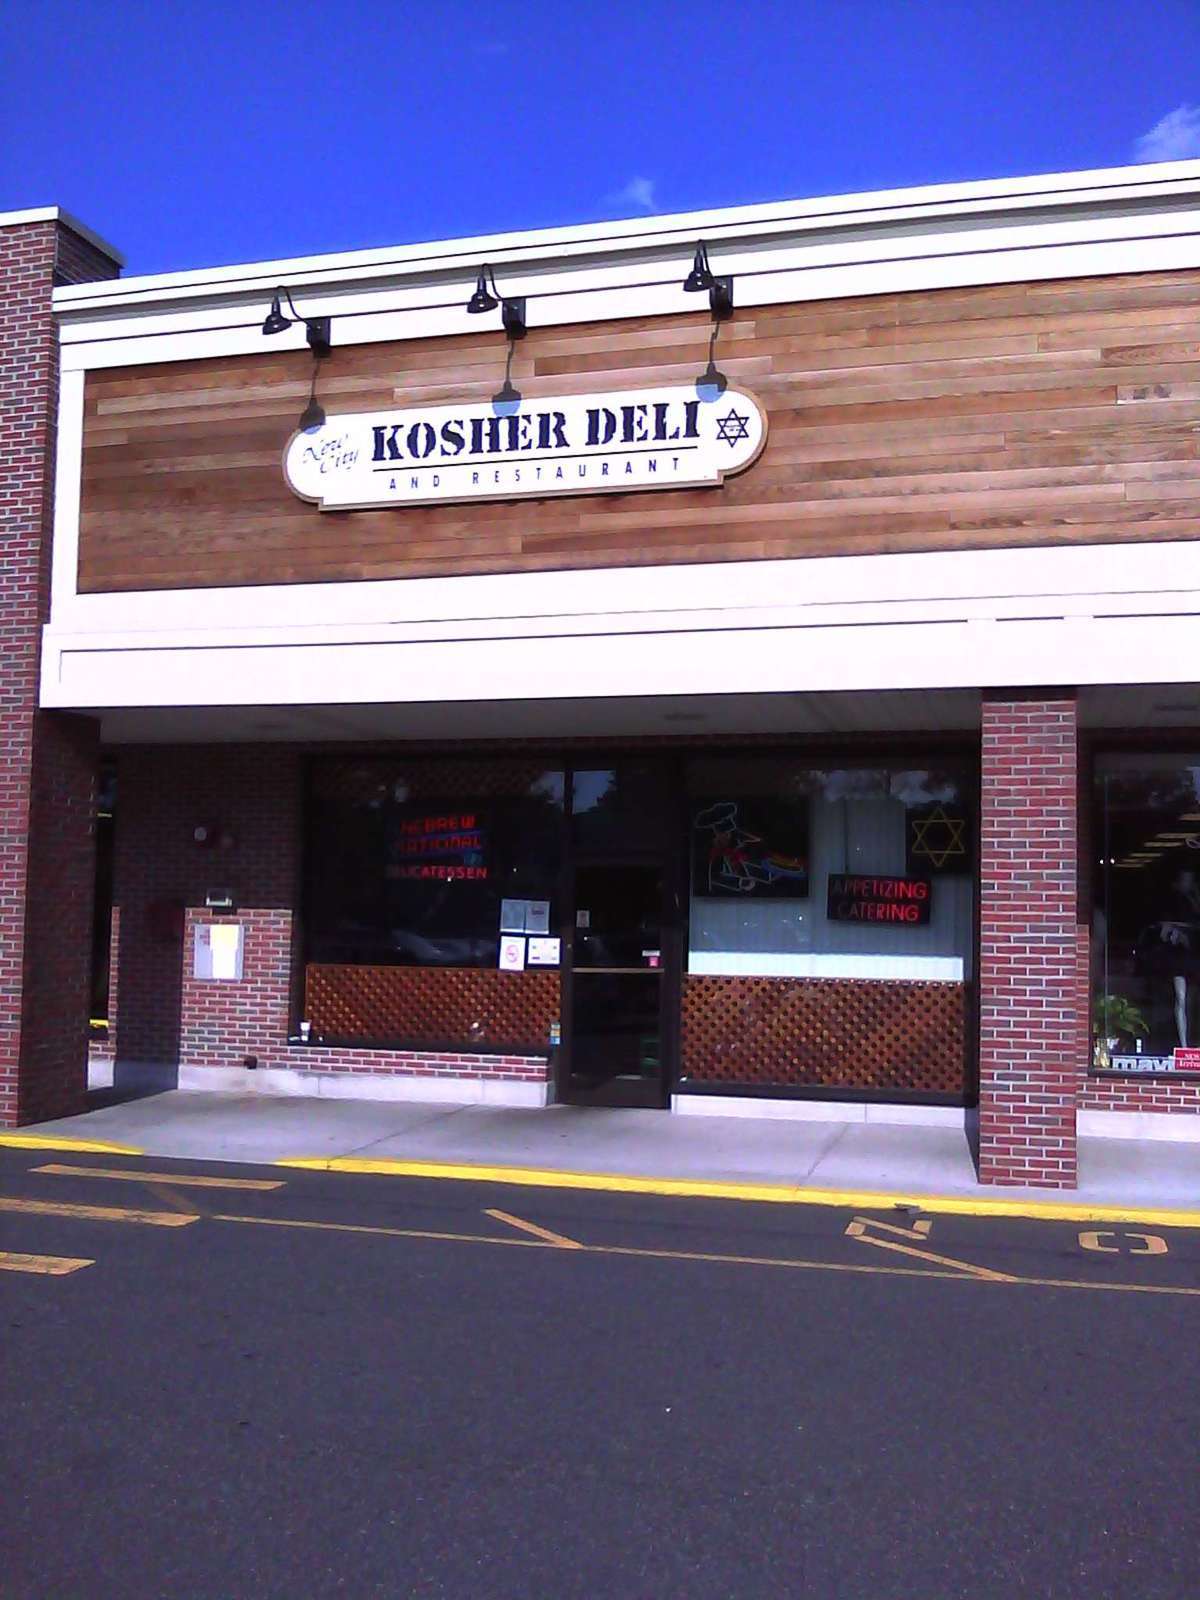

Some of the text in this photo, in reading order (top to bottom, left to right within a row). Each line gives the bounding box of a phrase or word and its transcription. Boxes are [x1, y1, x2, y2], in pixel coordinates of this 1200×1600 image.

[371, 400, 700, 461] KOSHER DELI
[389, 458, 679, 489] AND RESTAURANT
[393, 834, 482, 856] ATIONAL
[387, 864, 488, 880] LICATESSEN
[833, 880, 926, 899] APPETIZING
[838, 901, 919, 921] CATERING
